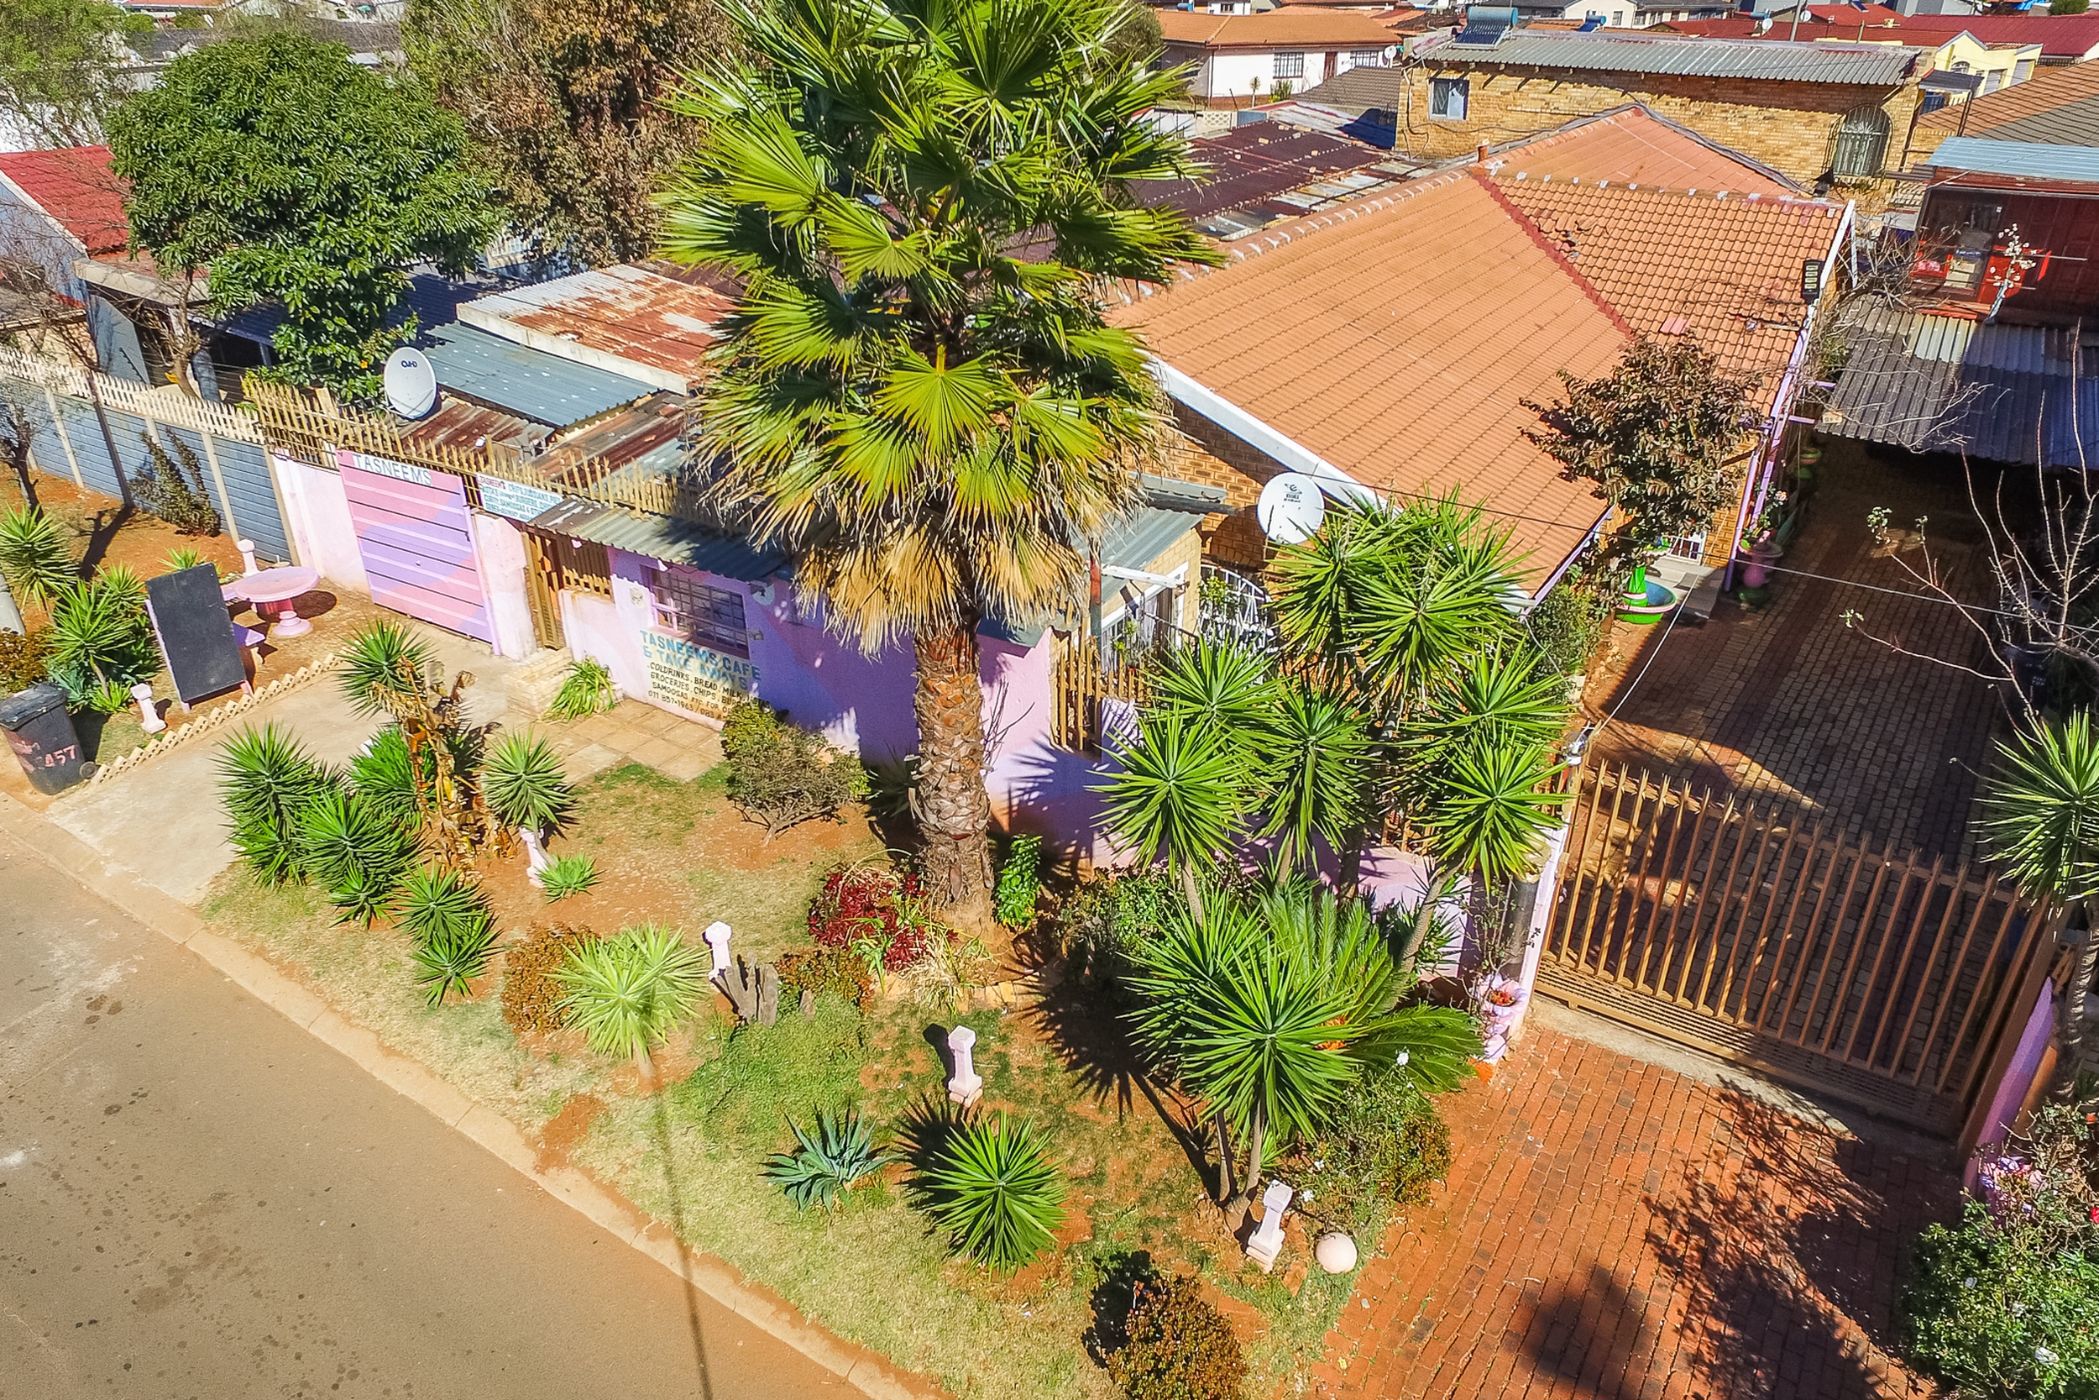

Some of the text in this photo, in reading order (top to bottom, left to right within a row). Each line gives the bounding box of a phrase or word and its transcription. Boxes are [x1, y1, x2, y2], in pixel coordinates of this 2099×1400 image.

[352, 453, 432, 485] TASNEEMS
[657, 649, 692, 672] TAKE
[723, 656, 761, 681] CAFE
[650, 672, 690, 691] GROCERIES
[693, 686, 717, 700] CHIPS
[652, 682, 689, 700] SAMOOSAS
[694, 677, 718, 690] BREAD
